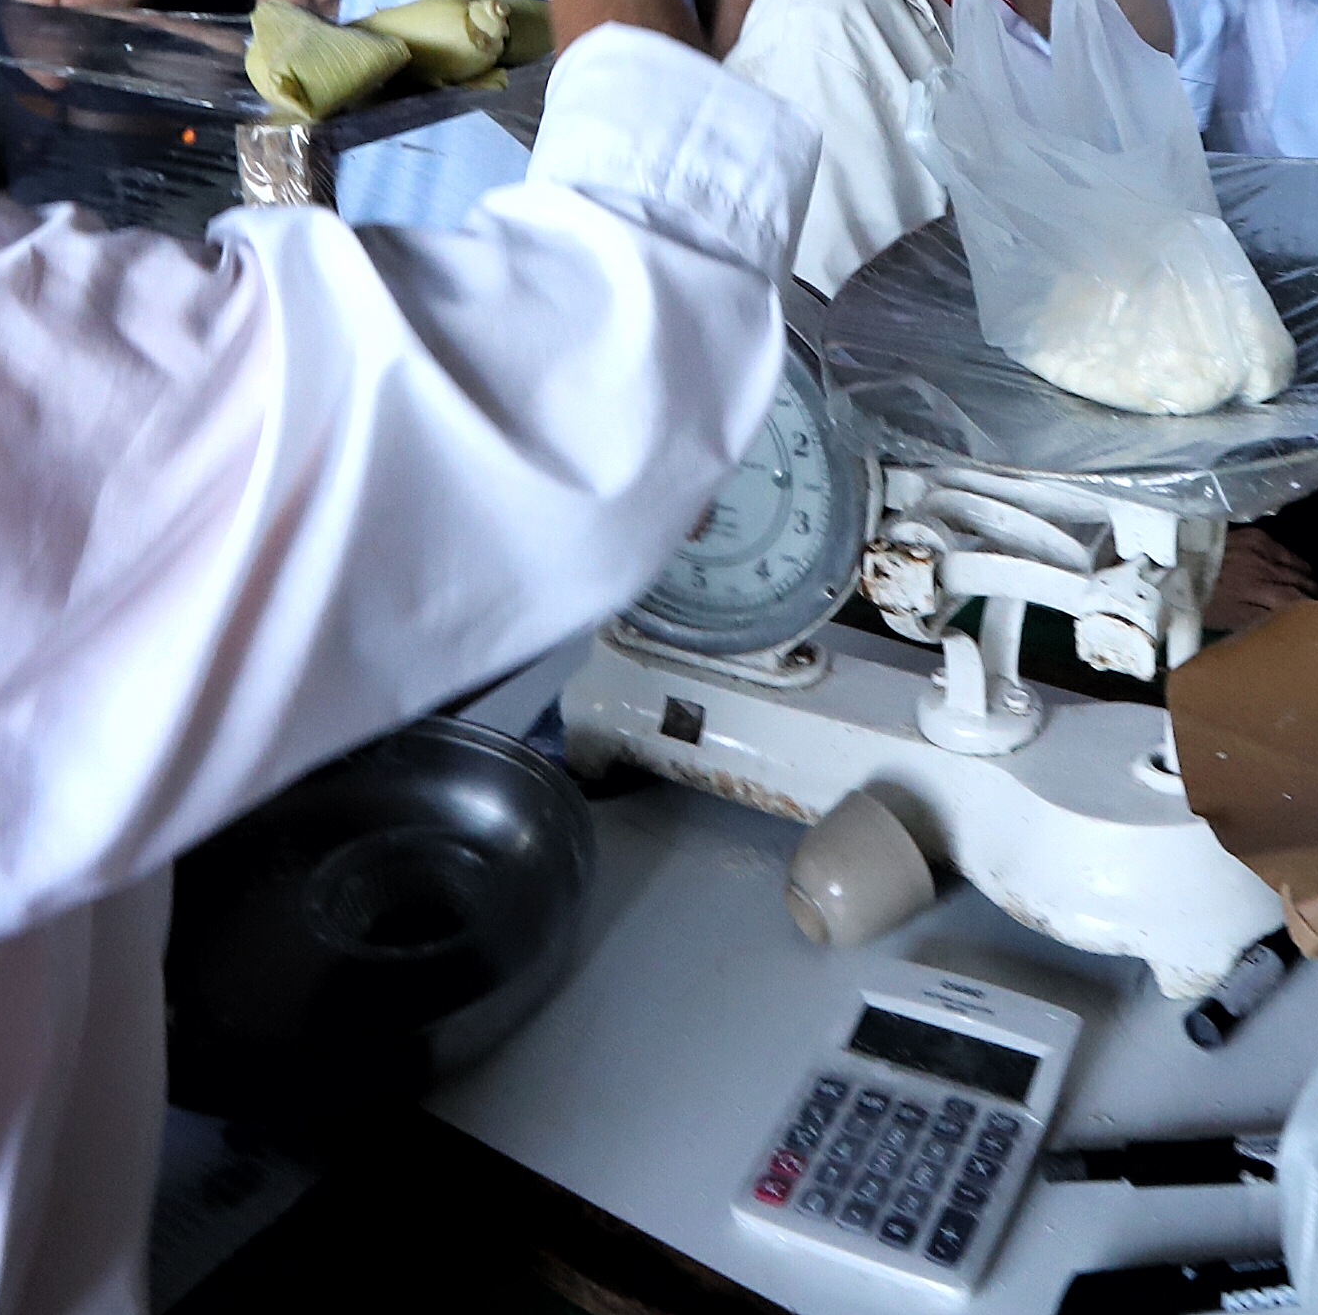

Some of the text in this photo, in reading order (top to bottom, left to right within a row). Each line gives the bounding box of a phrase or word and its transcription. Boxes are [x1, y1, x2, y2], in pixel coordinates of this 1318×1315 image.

[794, 430, 810, 458] 2
[794, 509, 811, 536] 3
[754, 557, 772, 581] 4
